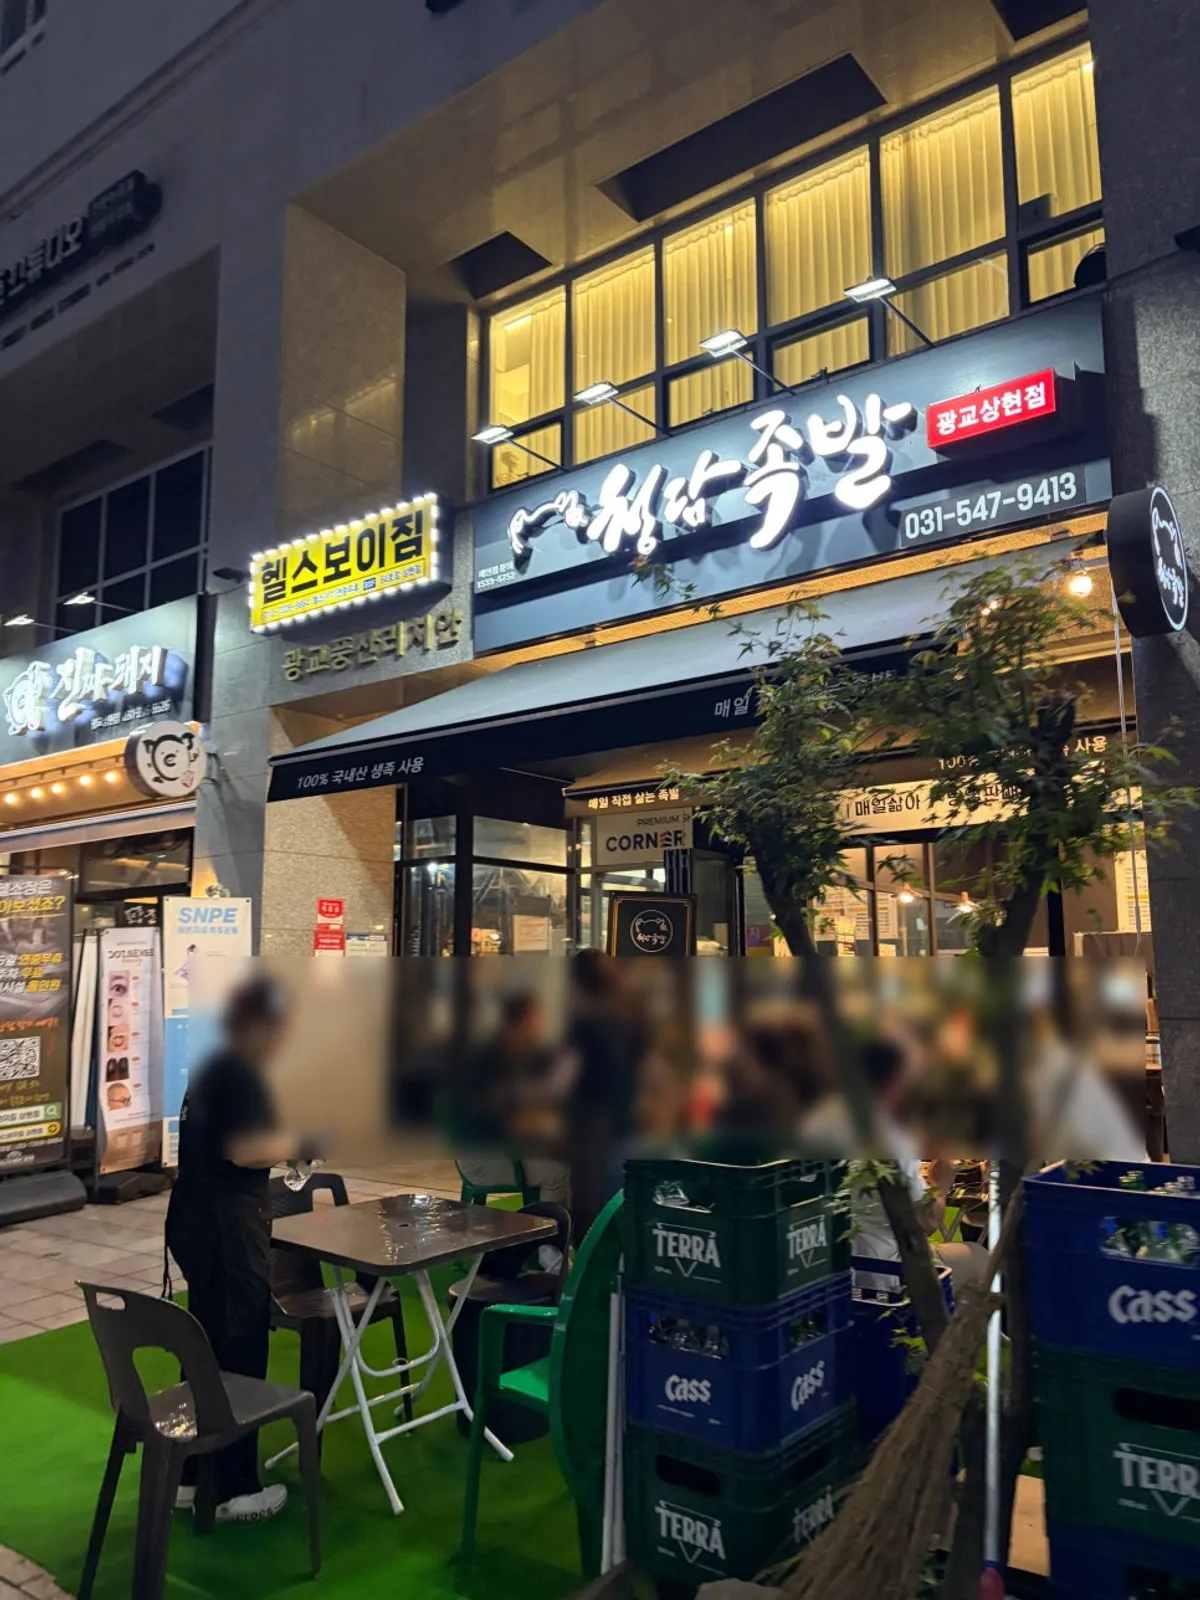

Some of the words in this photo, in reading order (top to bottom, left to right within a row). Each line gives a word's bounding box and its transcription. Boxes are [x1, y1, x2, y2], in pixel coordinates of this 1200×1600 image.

[936, 381, 1046, 436] 광교상현점
[905, 471, 1077, 540] 031-547-9413
[261, 510, 423, 605] 헬스보이짐
[714, 695, 749, 719] 매일
[1074, 735, 1108, 753] 사용
[297, 772, 329, 790] 100%
[331, 765, 368, 785] 국내산
[370, 760, 395, 780] 생족
[397, 756, 425, 774] 사용
[588, 796, 609, 810] 매일
[611, 793, 632, 808] 직접
[657, 787, 680, 802] 족발
[855, 793, 922, 817] 매일삶아
[637, 815, 680, 827] PREMIUM
[606, 829, 686, 853] CORNER
[177, 906, 239, 924] SNPE
[652, 1227, 722, 1269] TERRA
[786, 1221, 828, 1260] TERRA
[1107, 1285, 1198, 1325] Cass
[665, 1374, 712, 1404] Cass
[790, 1360, 825, 1412] Cass
[654, 1504, 726, 1561] TERRA
